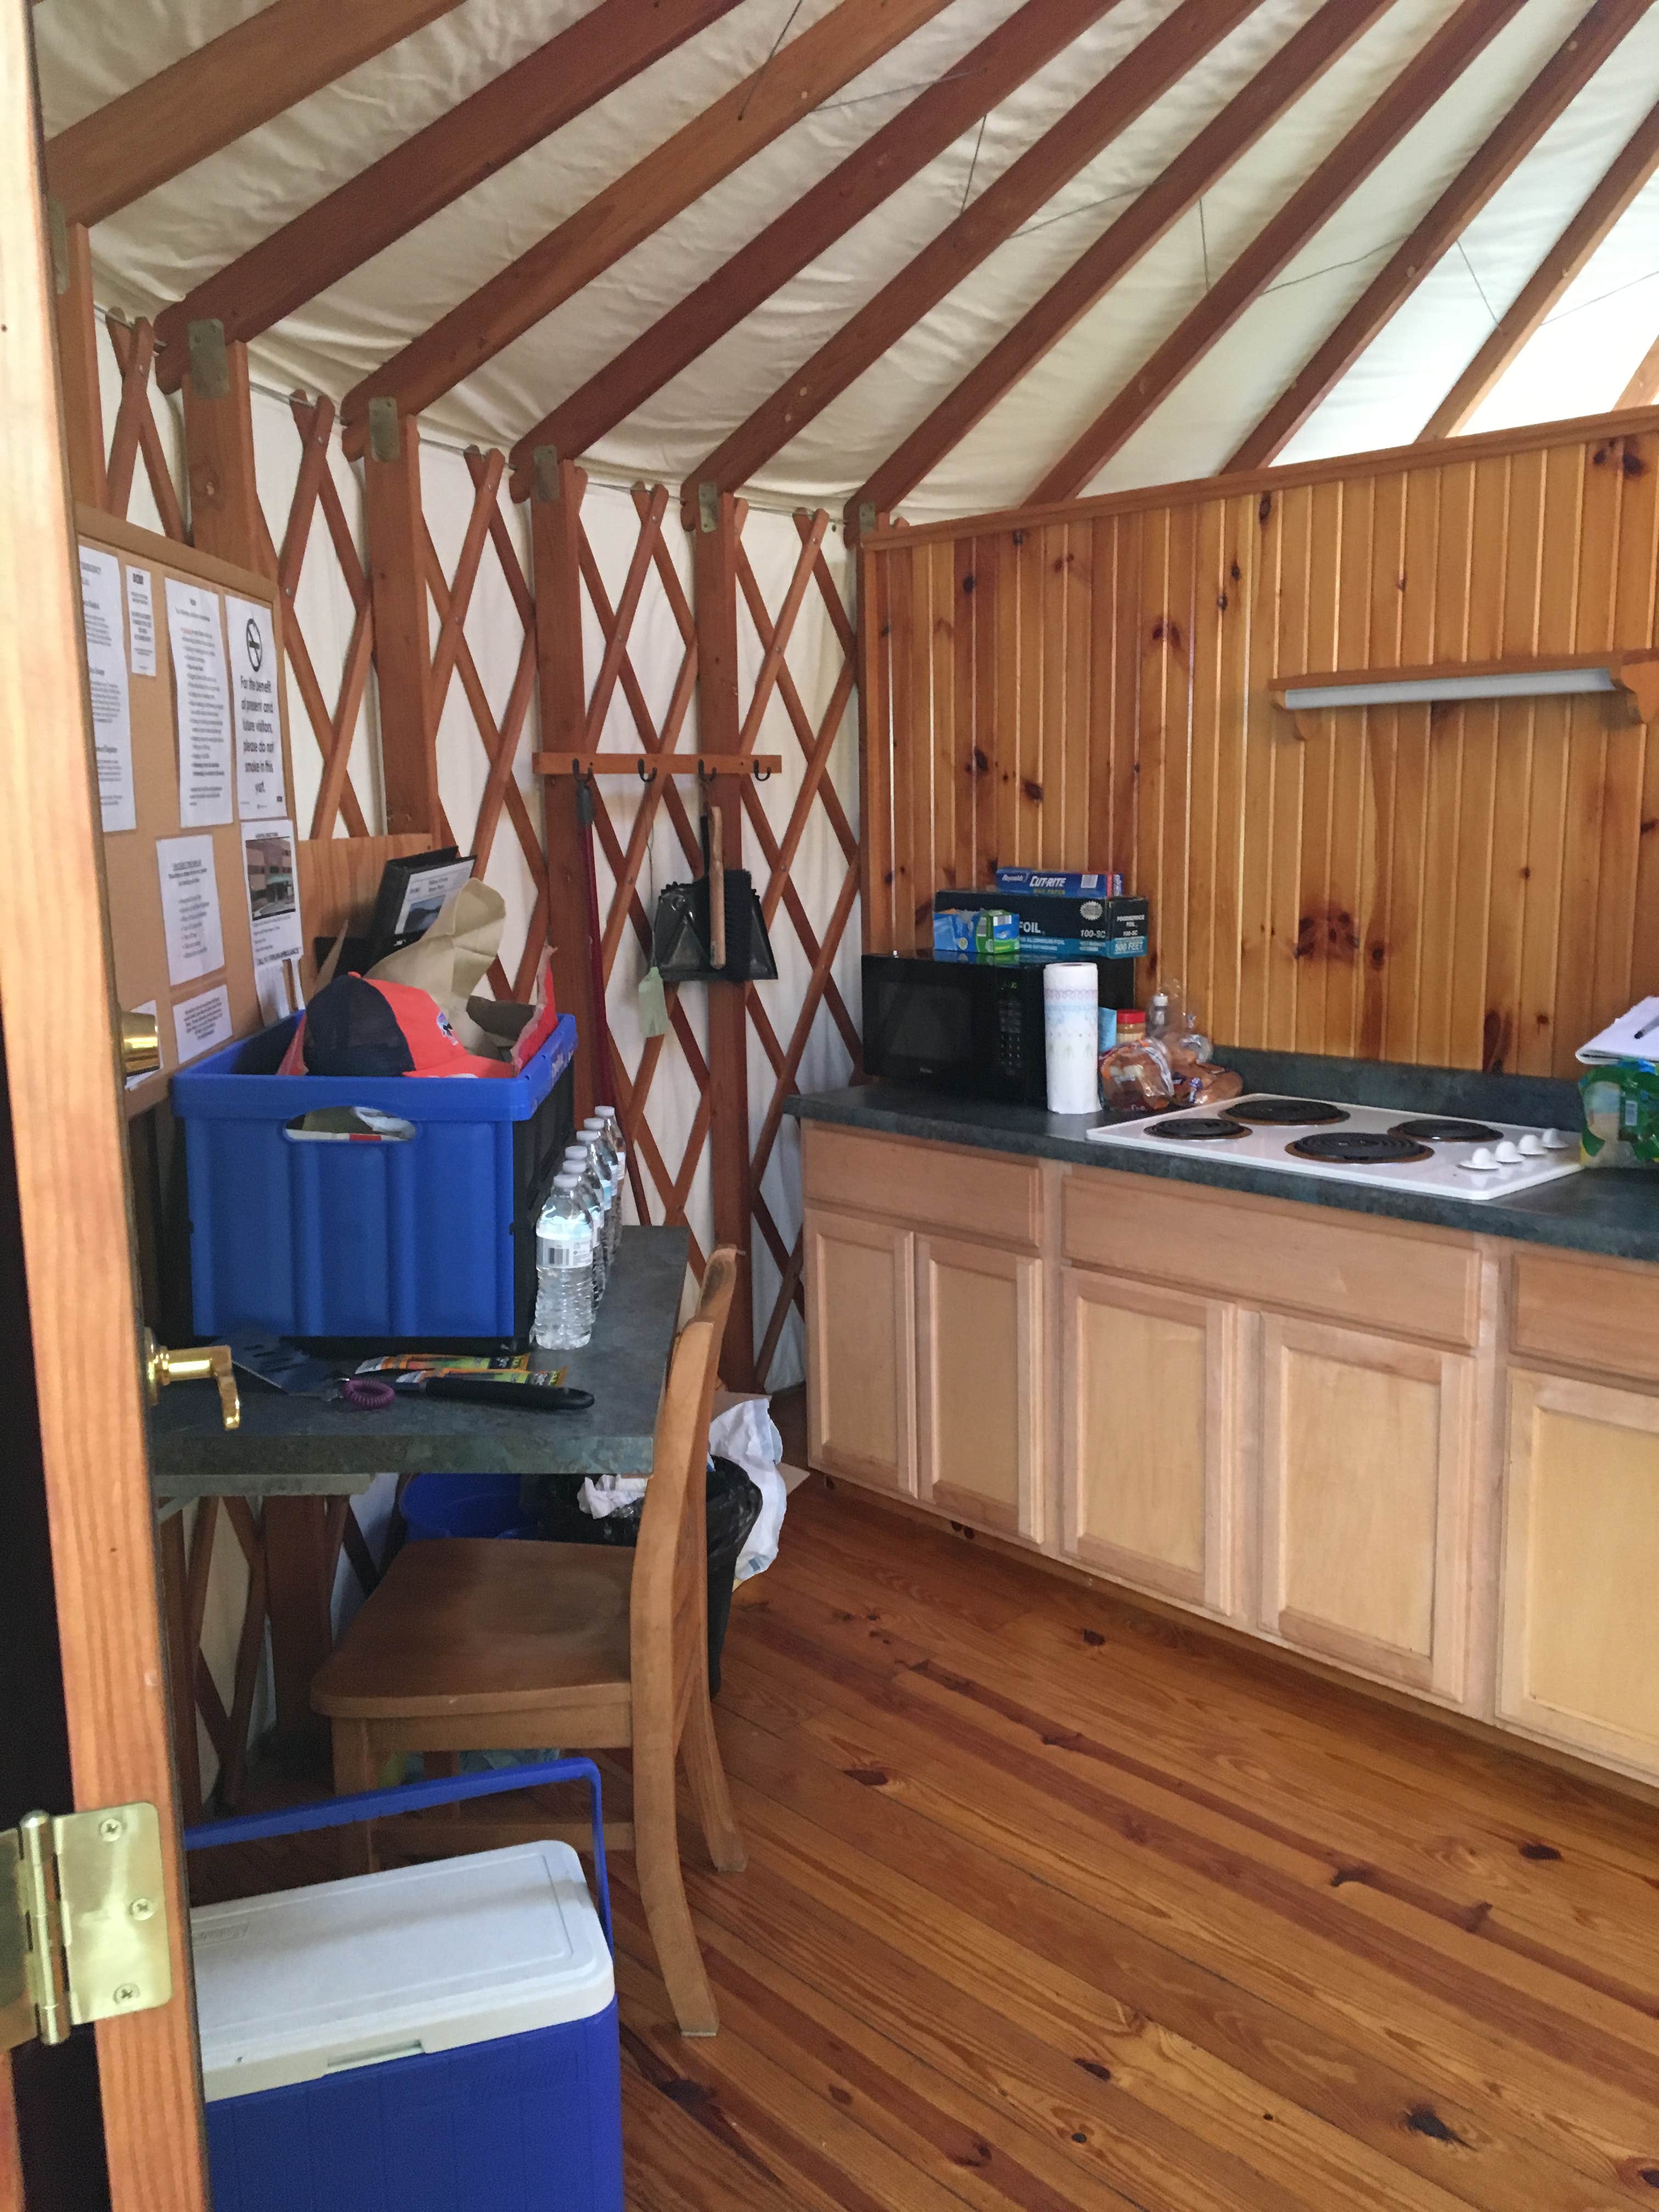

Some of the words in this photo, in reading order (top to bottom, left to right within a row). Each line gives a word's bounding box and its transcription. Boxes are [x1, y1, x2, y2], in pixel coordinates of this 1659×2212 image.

[256, 680, 272, 693] benefit
[246, 699, 262, 713] present
[263, 702, 273, 714] and
[242, 718, 255, 731] future
[244, 738, 257, 755] please
[259, 740, 266, 753] do
[245, 760, 259, 772] smoke
[260, 760, 264, 772] in
[265, 760, 273, 773] this
[1029, 876, 1066, 888] CUT-RITE
[1080, 929, 1106, 939] 100-SC
[1115, 943, 1126, 952] 500
[1127, 941, 1144, 951] FEET
